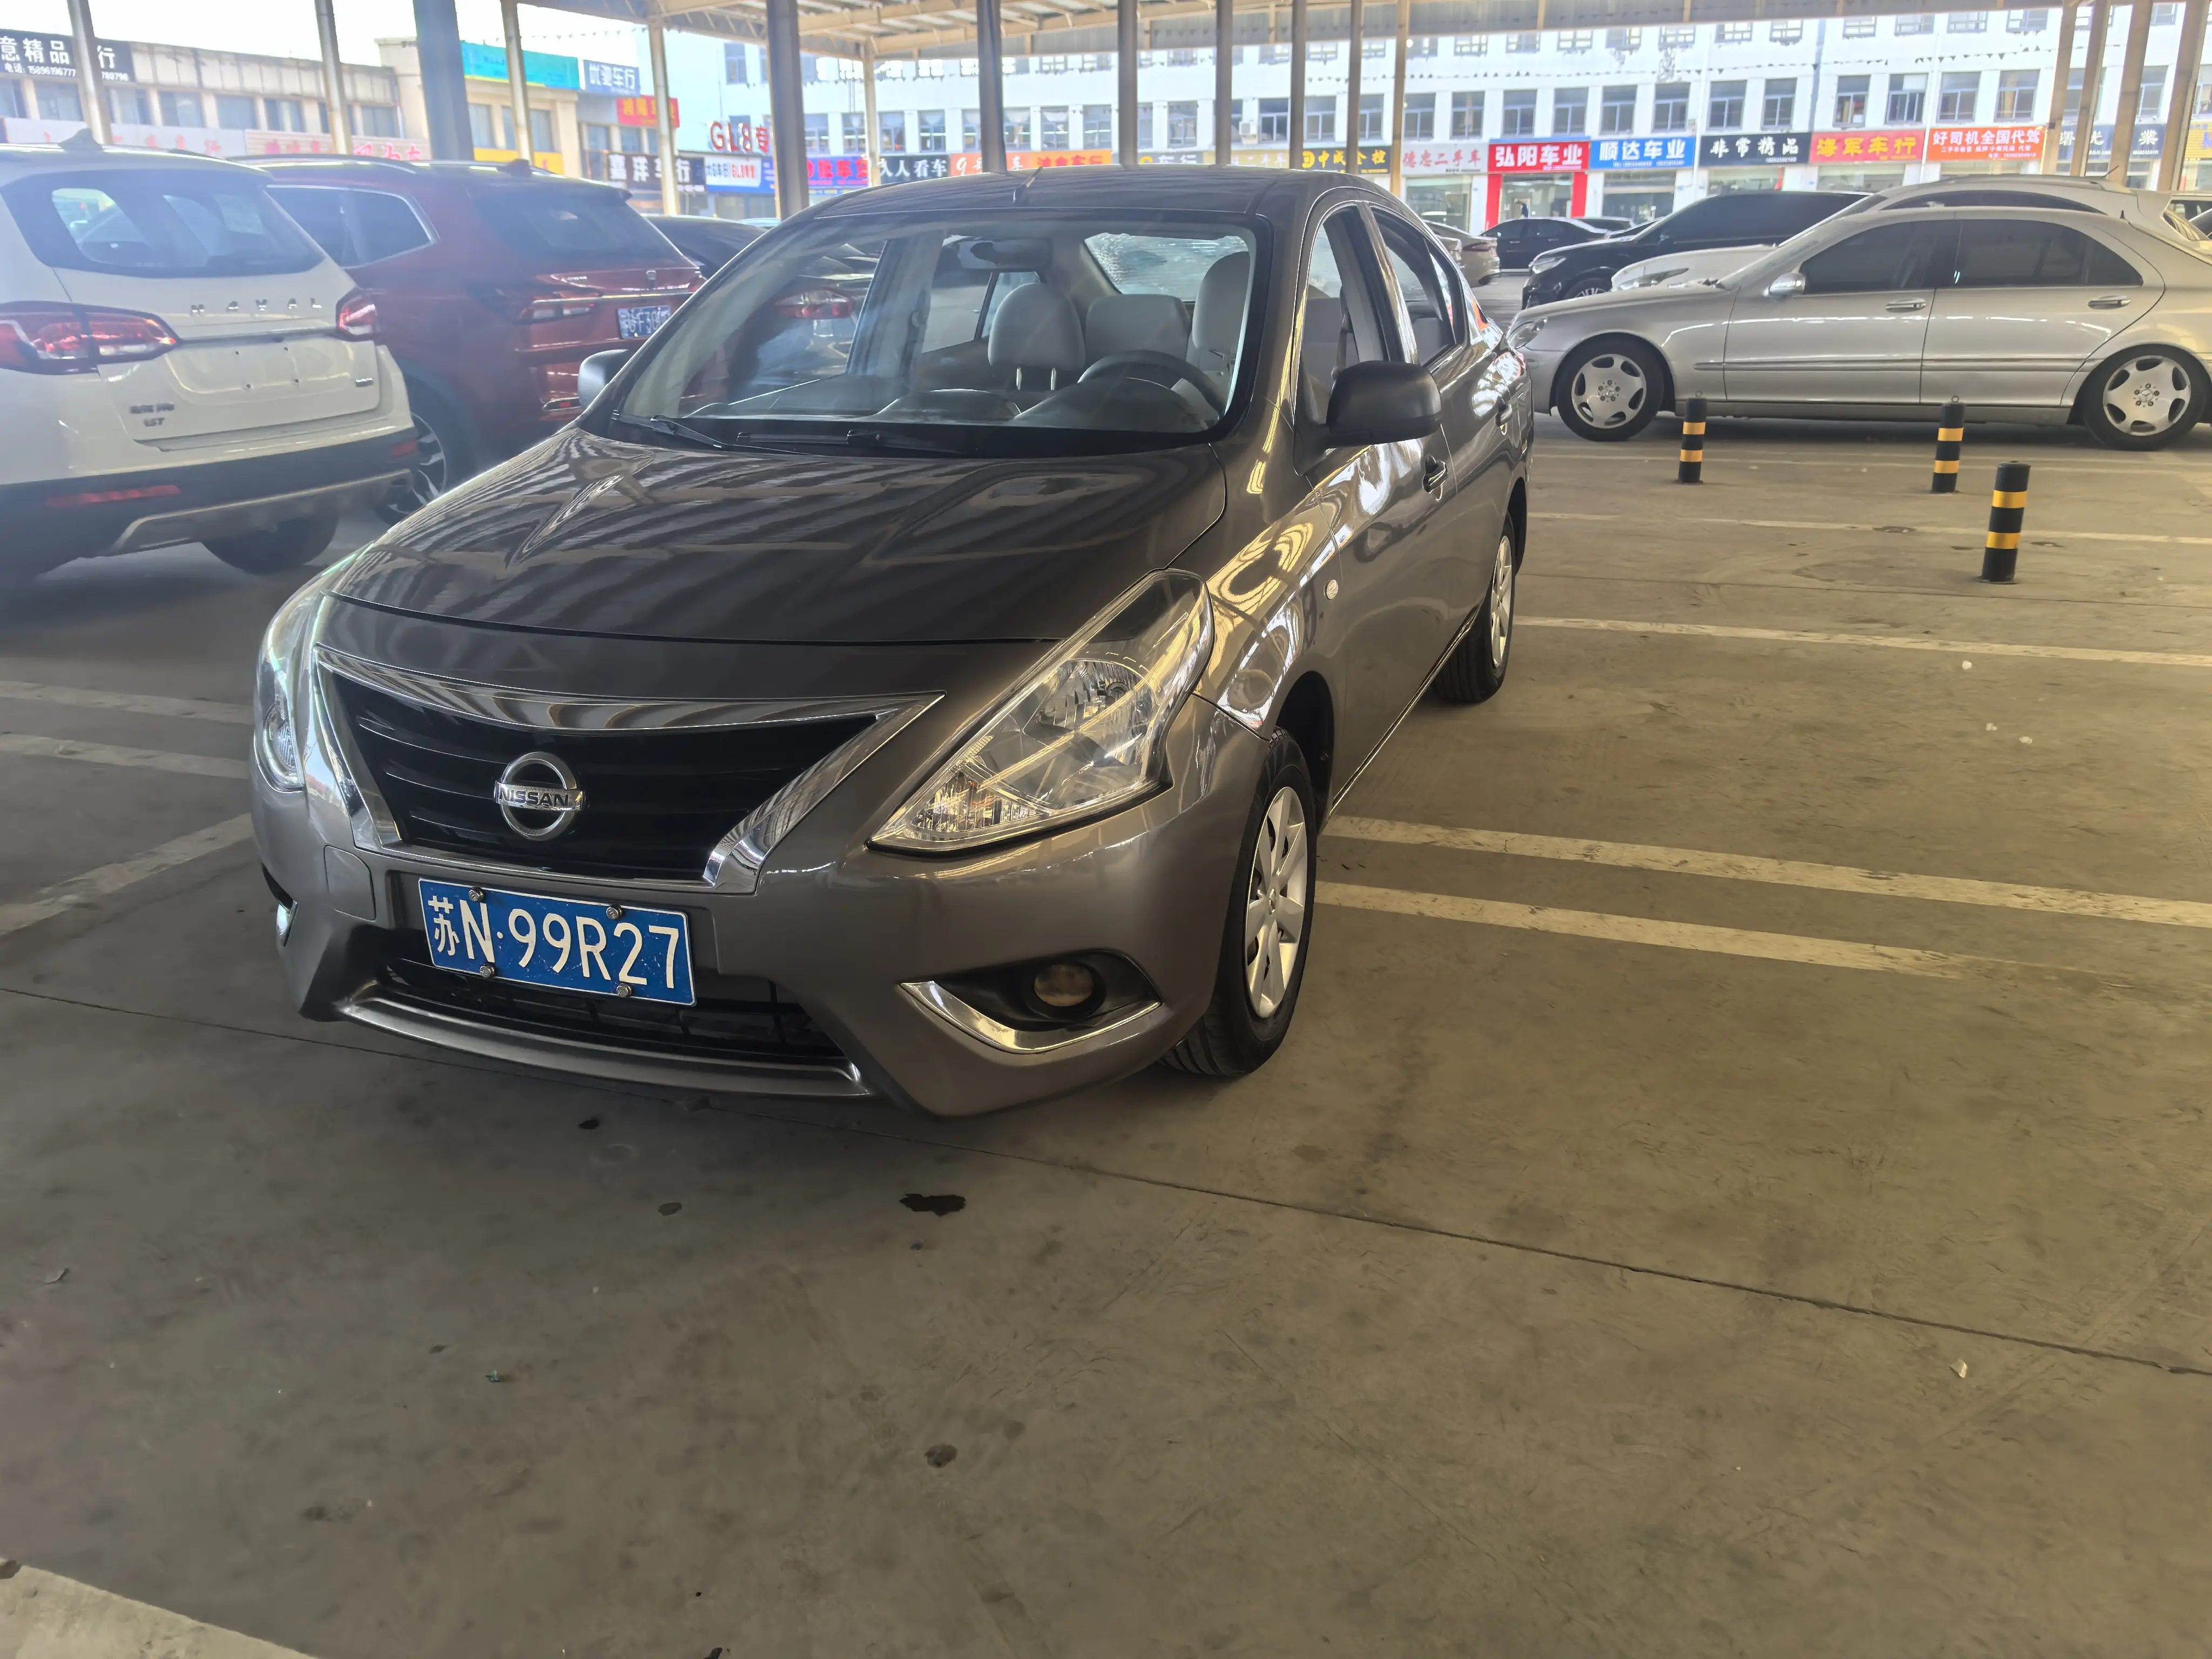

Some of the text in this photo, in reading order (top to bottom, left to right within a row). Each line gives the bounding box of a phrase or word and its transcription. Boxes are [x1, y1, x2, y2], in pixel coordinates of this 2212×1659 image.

[1710, 136, 1799, 158] 非常精品
[1817, 136, 1917, 157] 海军车行
[1933, 129, 2040, 146] 好司机全国代驾
[1495, 144, 1583, 167] 弘阳车业
[1599, 139, 1686, 161] 顺达车业
[498, 789, 569, 807] NISSAN
